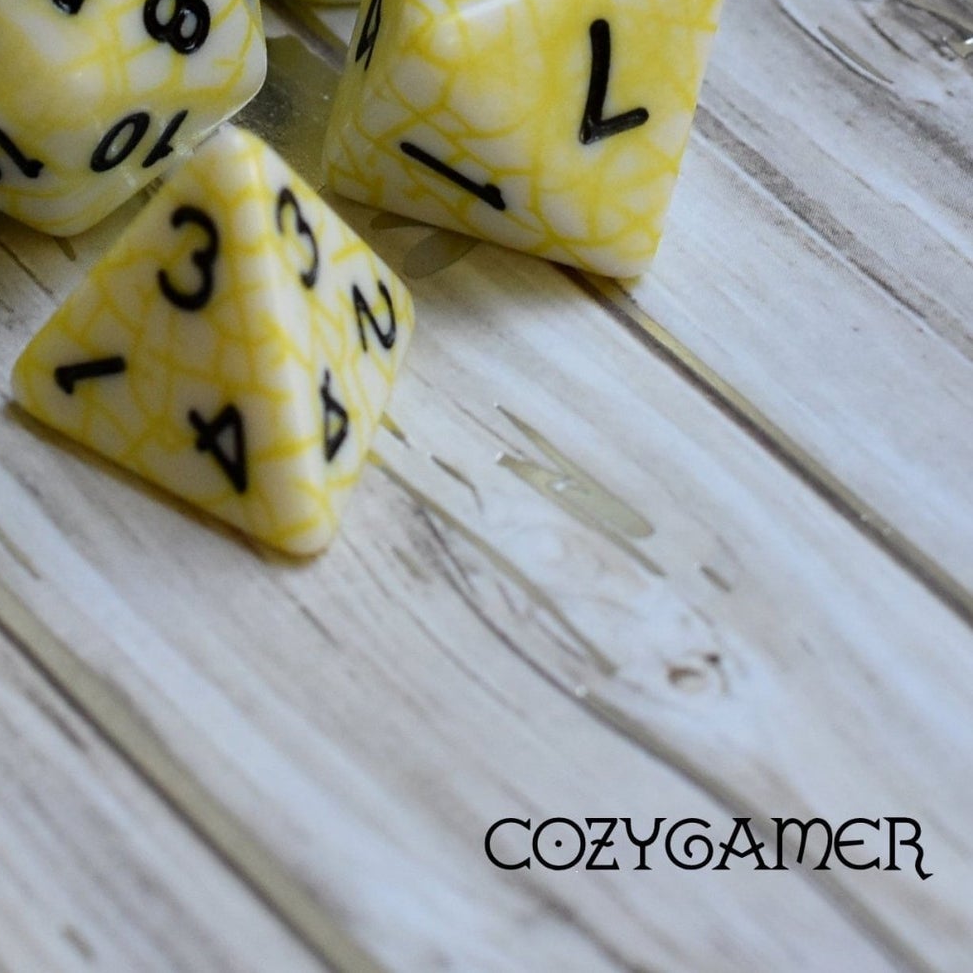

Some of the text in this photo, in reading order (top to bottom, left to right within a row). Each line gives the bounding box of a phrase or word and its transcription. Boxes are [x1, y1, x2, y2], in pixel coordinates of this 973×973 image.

[579, 19, 649, 145] 7
[90, 111, 187, 172] 10
[400, 141, 507, 211] 1
[158, 205, 221, 311] 3
[277, 187, 321, 289] 3
[352, 279, 397, 351] 2
[54, 355, 126, 395] 1
[321, 368, 349, 462] 4
[187, 403, 248, 494] 4
